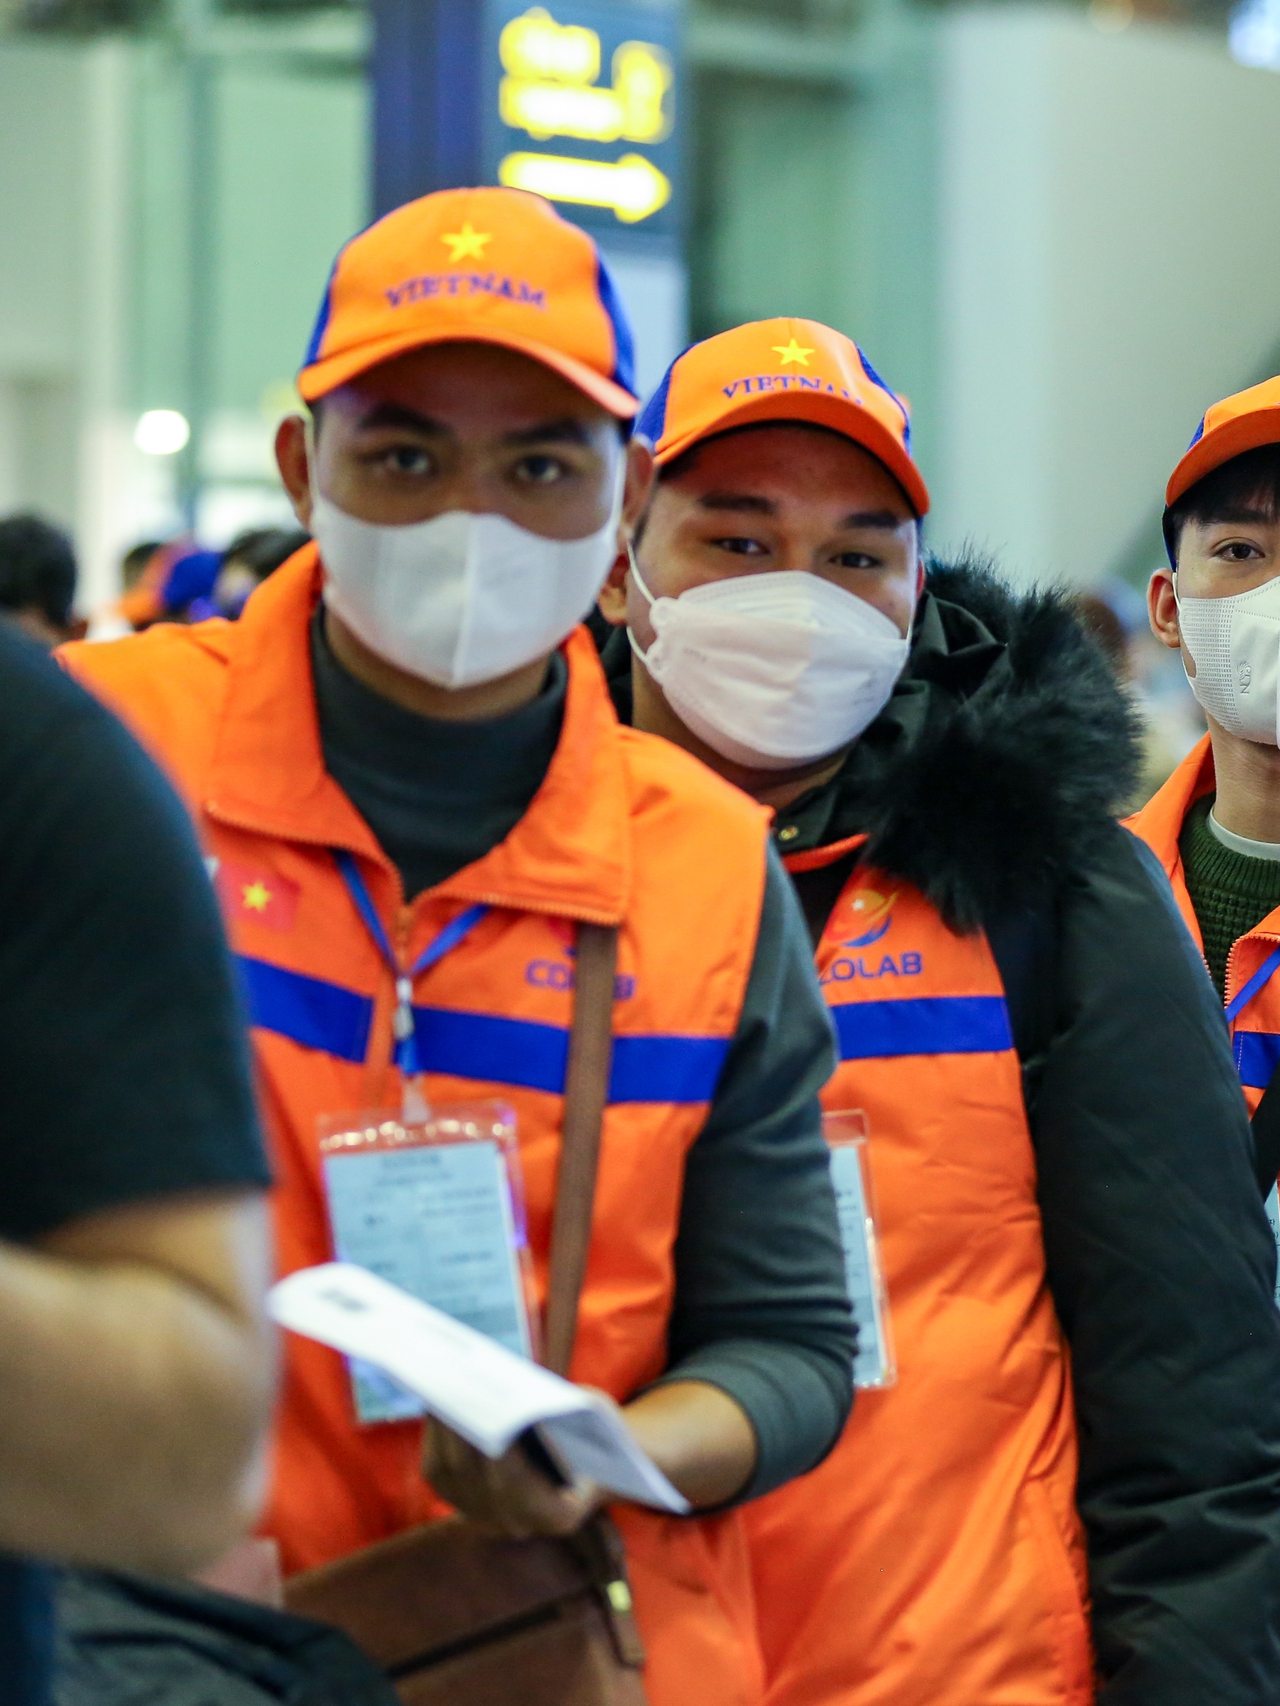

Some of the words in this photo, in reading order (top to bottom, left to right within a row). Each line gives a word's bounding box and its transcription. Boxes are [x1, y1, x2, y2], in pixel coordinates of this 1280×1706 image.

[385, 273, 547, 311] VIETNAM
[722, 375, 864, 406] VIETNA
[524, 959, 637, 1002] COB
